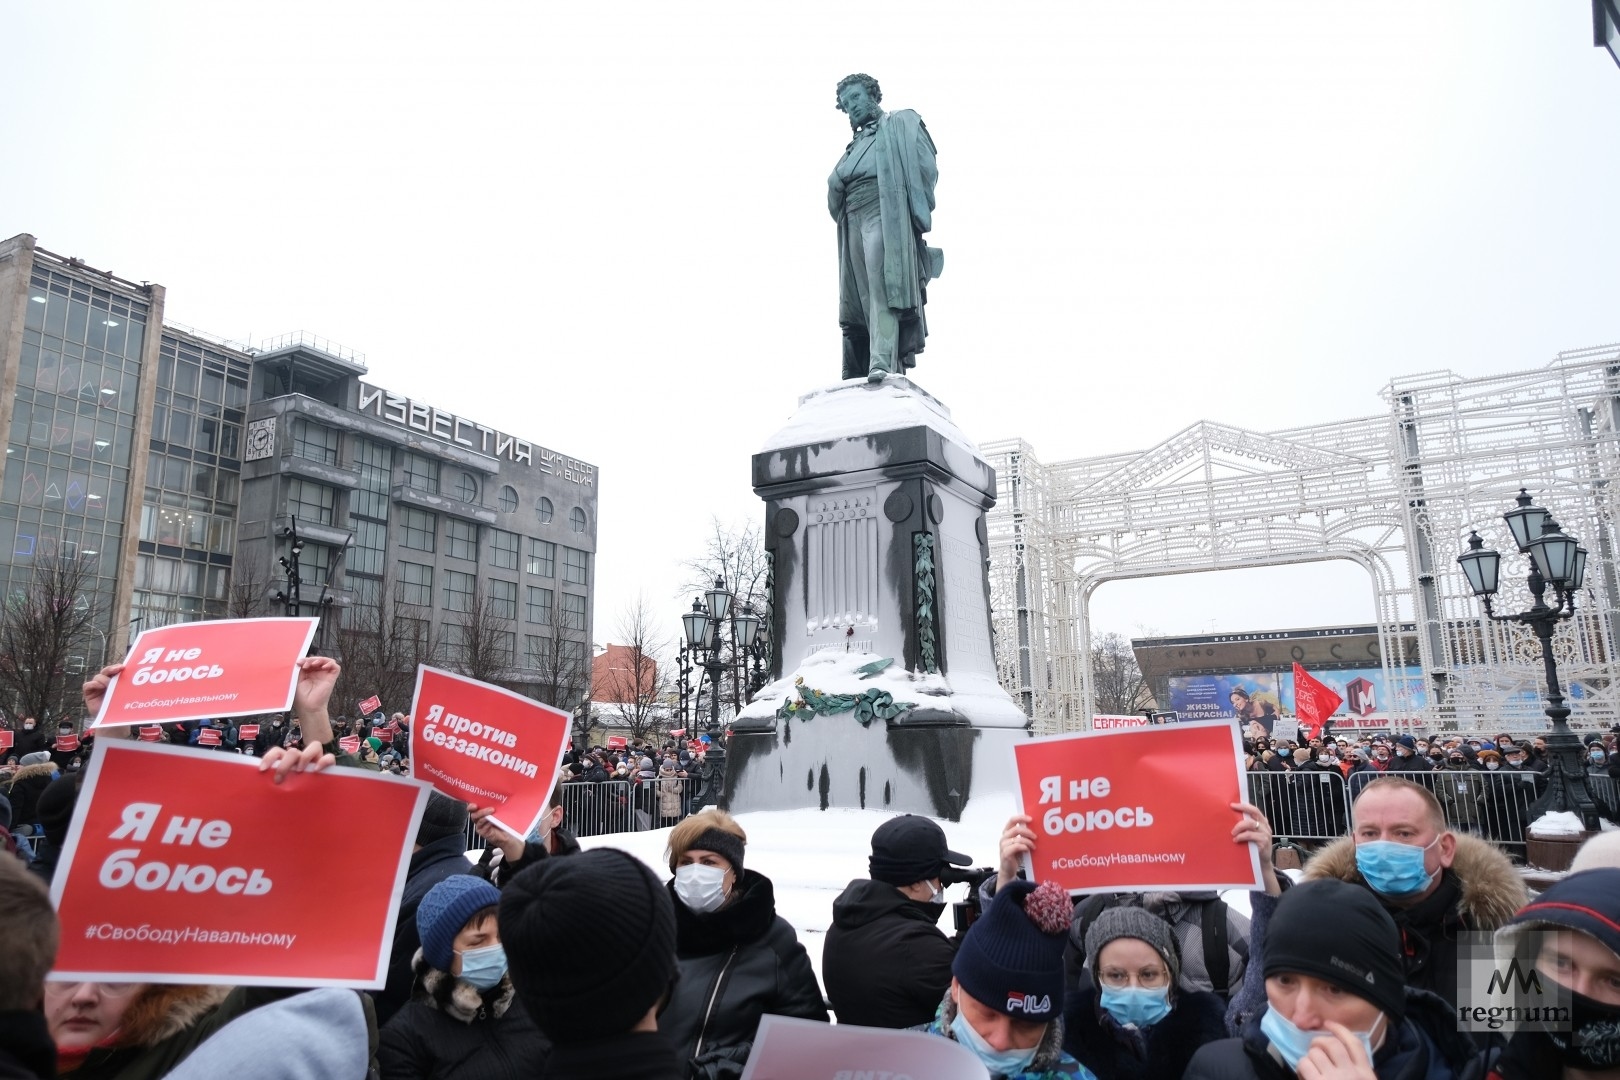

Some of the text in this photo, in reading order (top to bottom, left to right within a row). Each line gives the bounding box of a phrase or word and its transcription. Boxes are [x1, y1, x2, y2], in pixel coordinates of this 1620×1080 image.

[358, 383, 532, 466] ИЗВЕСТИЯ
[541, 449, 593, 474] ЦИК СССР
[565, 469, 593, 487] ВЦИК
[1214, 633, 1289, 642] МОСКОВСКИЙ
[138, 647, 202, 665] Я не
[132, 665, 224, 686] боюсь
[124, 693, 239, 710] #СвободуНавальному
[425, 704, 517, 748] Я против
[1357, 719, 1389, 727] ТЕАТР
[423, 724, 538, 779] беззакония
[423, 763, 508, 803] #СвободуНавальному
[1038, 776, 1111, 804] Я не
[108, 802, 232, 848] Я не
[1043, 806, 1154, 836] боюсь
[98, 849, 272, 895] боюсь
[1052, 852, 1186, 869] #СвободуНавальному
[85, 923, 296, 949] #СвободуНавальному
[1007, 991, 1050, 1013] FILA
